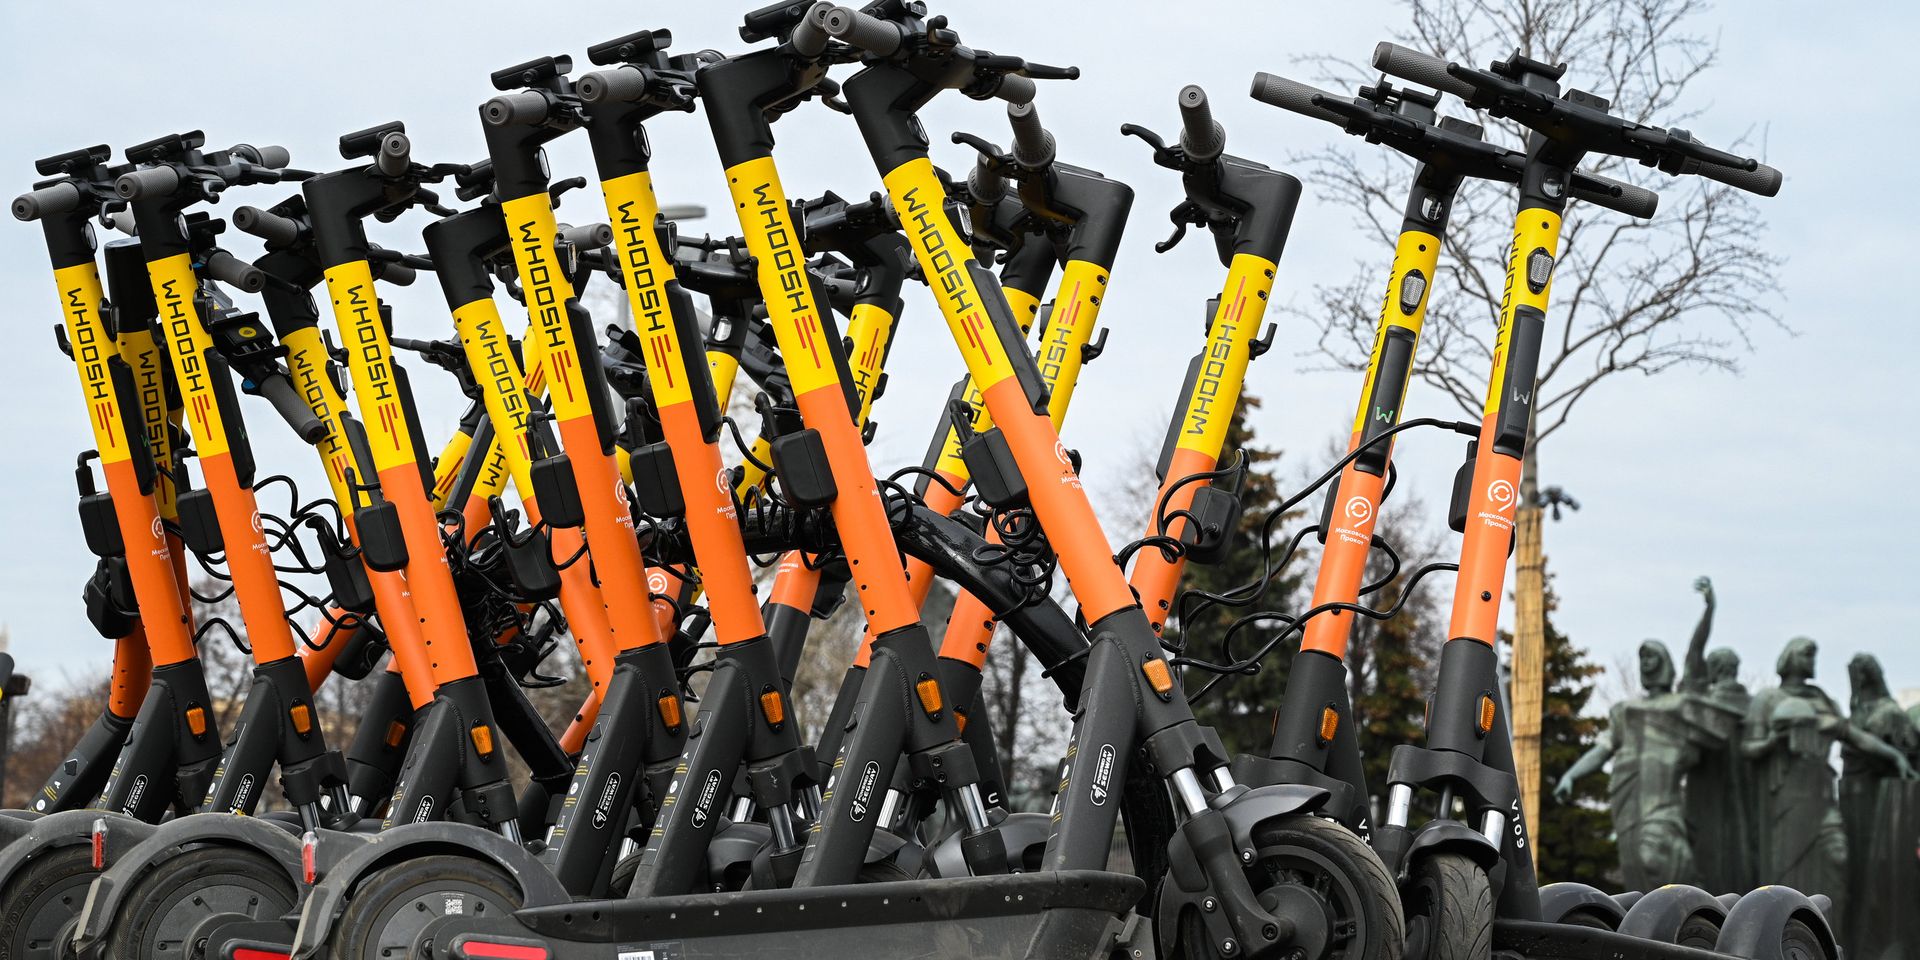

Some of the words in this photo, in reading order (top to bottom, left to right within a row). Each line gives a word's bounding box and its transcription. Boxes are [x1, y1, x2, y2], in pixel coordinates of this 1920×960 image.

[519, 221, 565, 347] WHOOSH
[618, 201, 665, 332] WHOOSH
[753, 183, 808, 313] WHOOSH
[903, 187, 973, 314] WHOOSH
[67, 287, 109, 399] WHOOSH
[161, 279, 205, 392] WHOOSH
[347, 284, 392, 401] WHOOSH
[475, 320, 527, 431] WHOOSH
[1187, 324, 1236, 435] WHOOSH
[139, 350, 166, 458] WHOOSH
[130, 780, 145, 809] SEGWAY
[236, 780, 252, 808] SEGWAY
[420, 801, 431, 823] GWAY
[603, 779, 618, 811] SEGWAY
[703, 776, 719, 809] SEGWAY
[862, 768, 877, 803] SEGWAY
[1101, 751, 1113, 787] SEGWAY
[1511, 798, 1525, 849] V109
